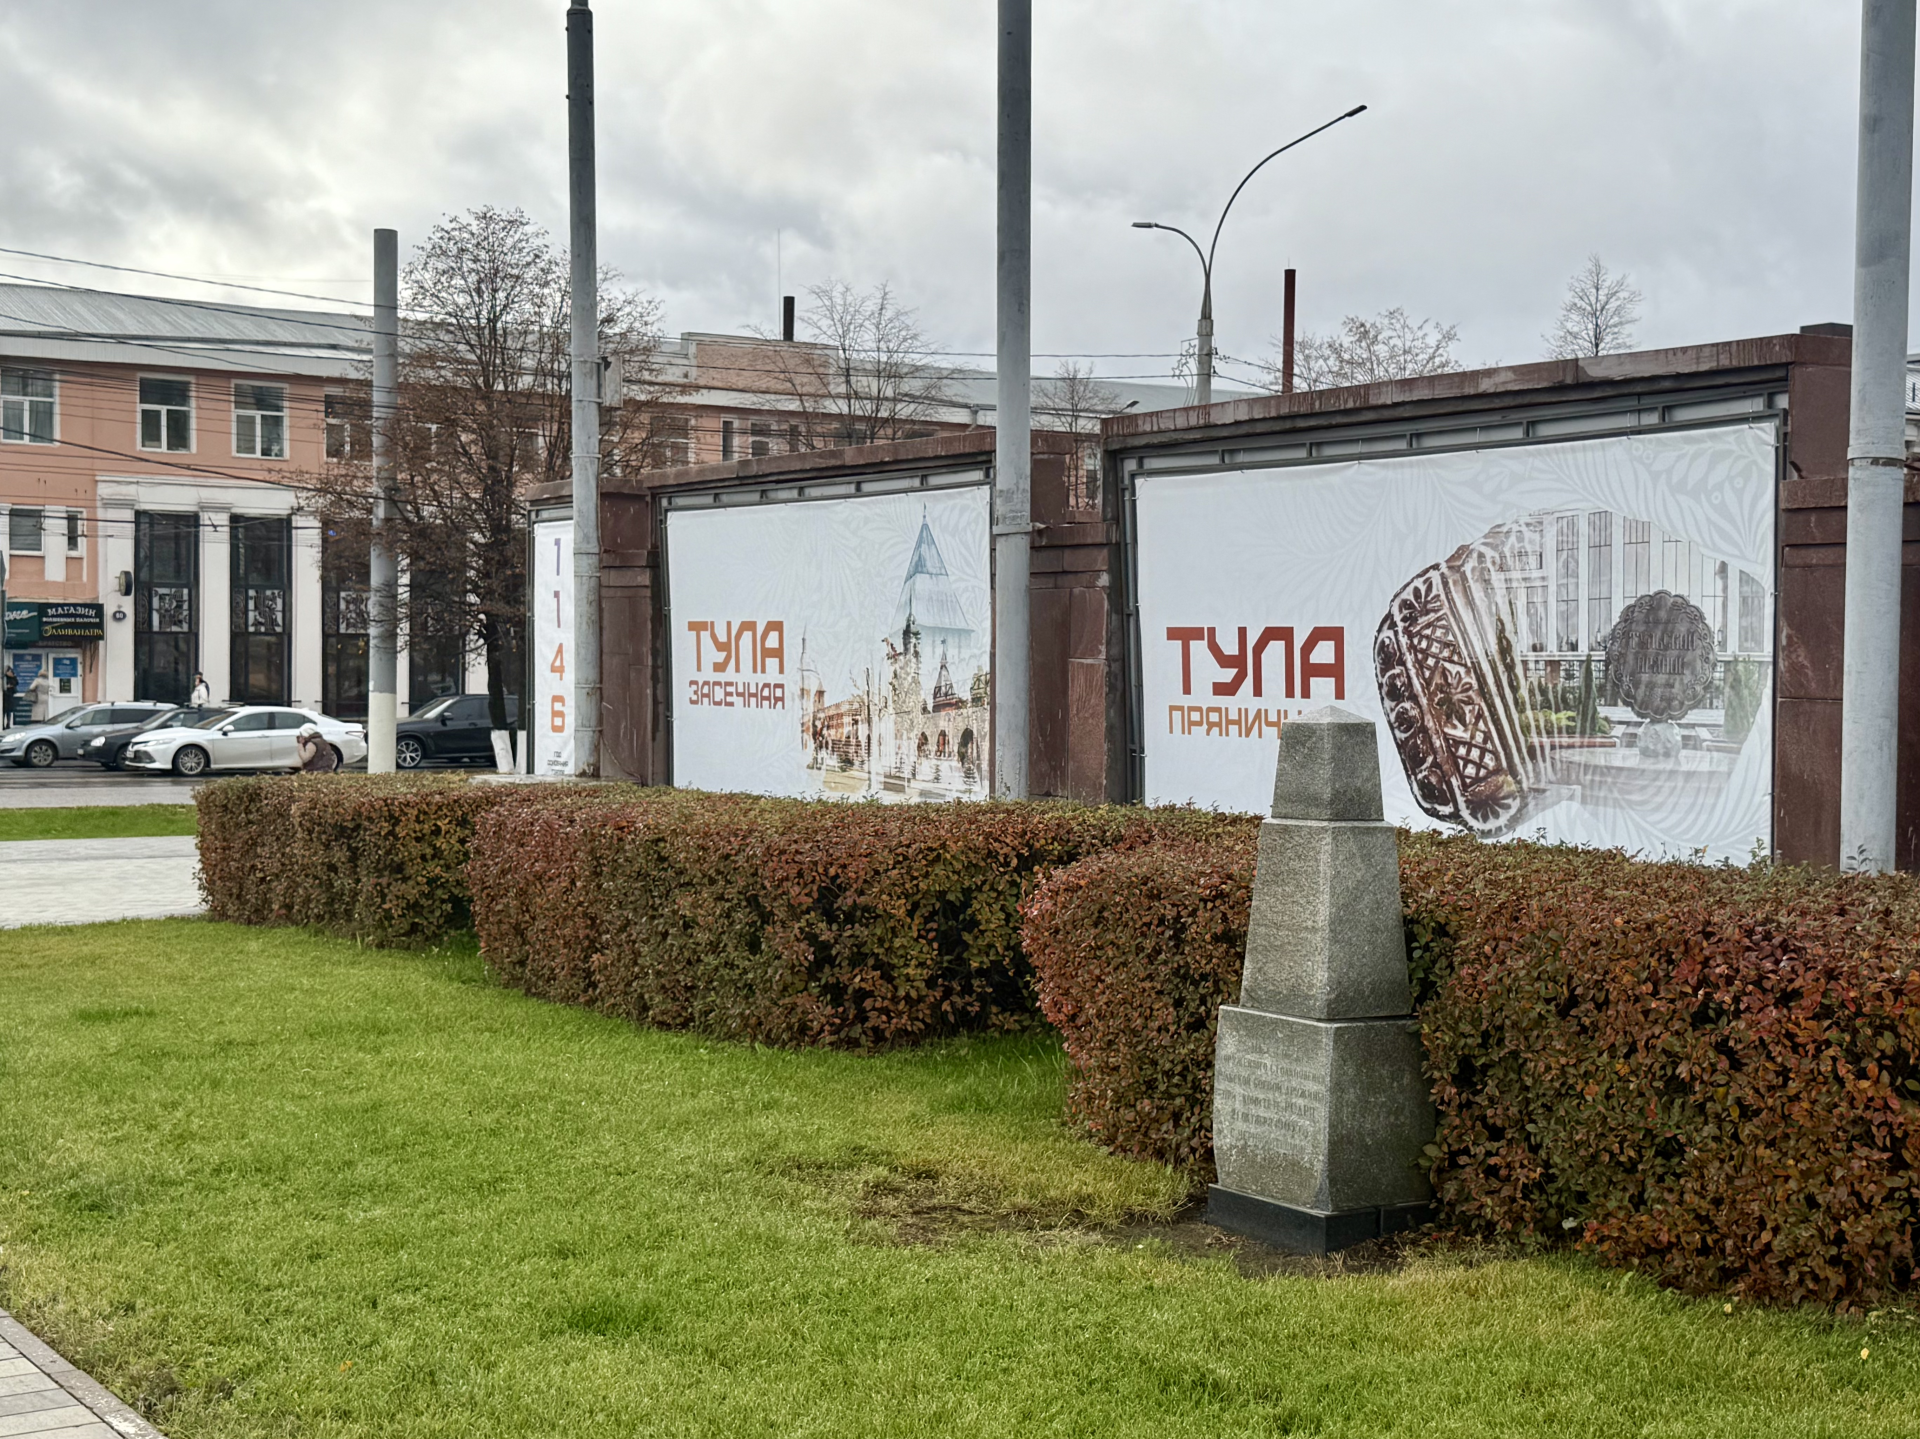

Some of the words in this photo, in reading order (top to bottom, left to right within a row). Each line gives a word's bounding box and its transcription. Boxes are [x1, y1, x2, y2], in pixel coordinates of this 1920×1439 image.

[47, 606, 96, 617] МАГАЗИН
[687, 620, 785, 675] ТУЛА
[1166, 626, 1346, 700] ТУЛА
[688, 680, 786, 710] ЗАСЕЧНАЯ
[1168, 705, 1303, 740] ПРЯНИЧ
